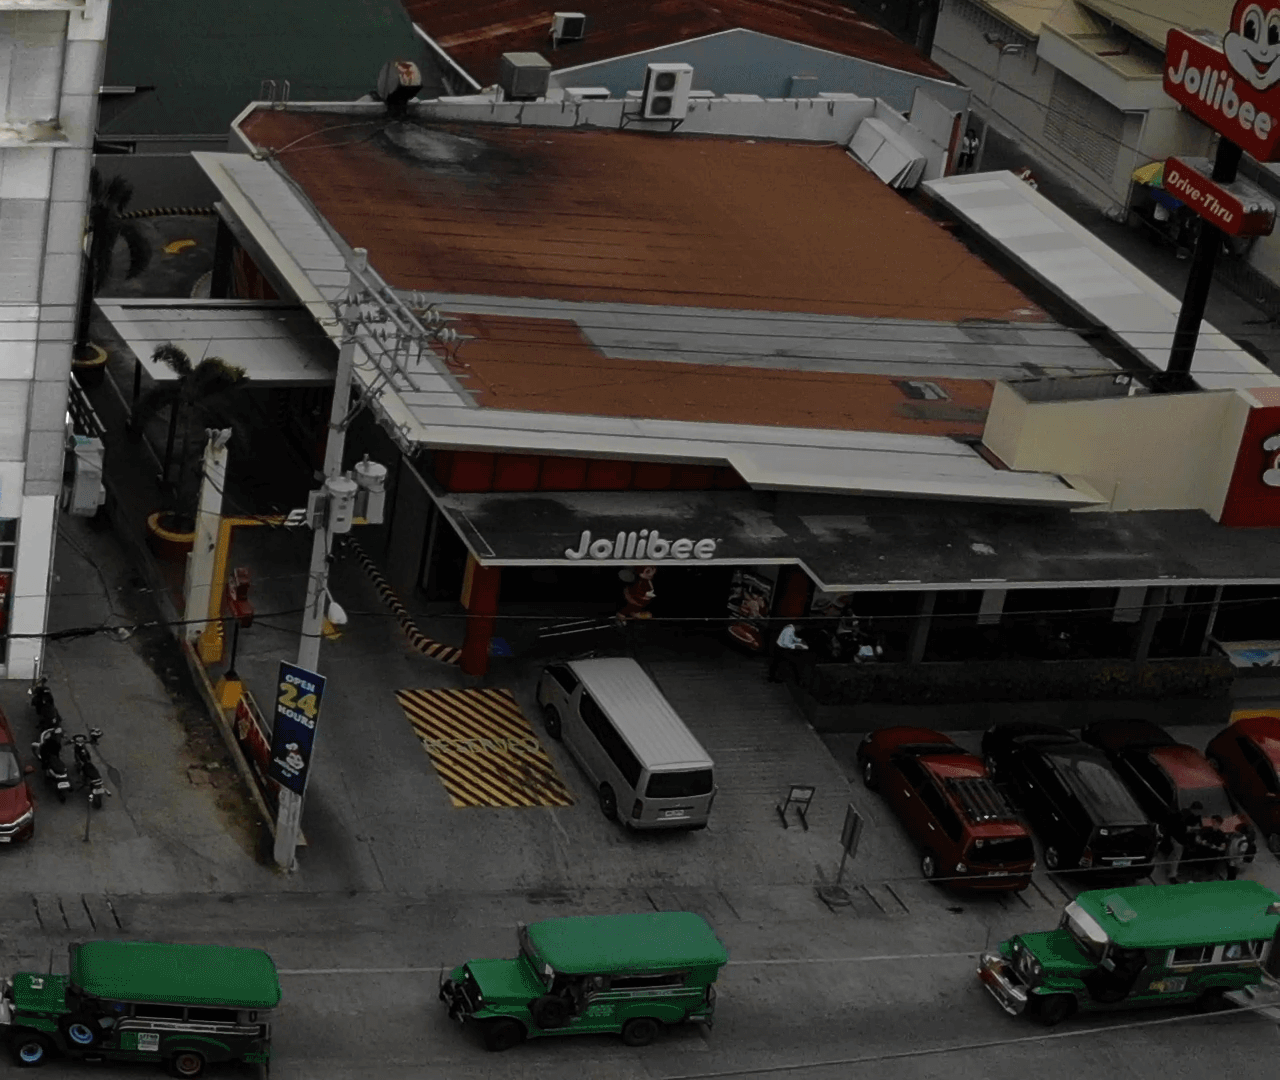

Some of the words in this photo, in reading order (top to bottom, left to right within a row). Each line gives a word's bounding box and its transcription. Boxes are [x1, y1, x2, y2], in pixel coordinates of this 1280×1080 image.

[1168, 49, 1272, 141] Jollibee
[1167, 170, 1234, 224] Drive-Thru
[564, 529, 717, 560] Jollibee
[279, 682, 318, 719] 24
[285, 674, 315, 693] OPEN
[277, 704, 315, 729] HOURS
